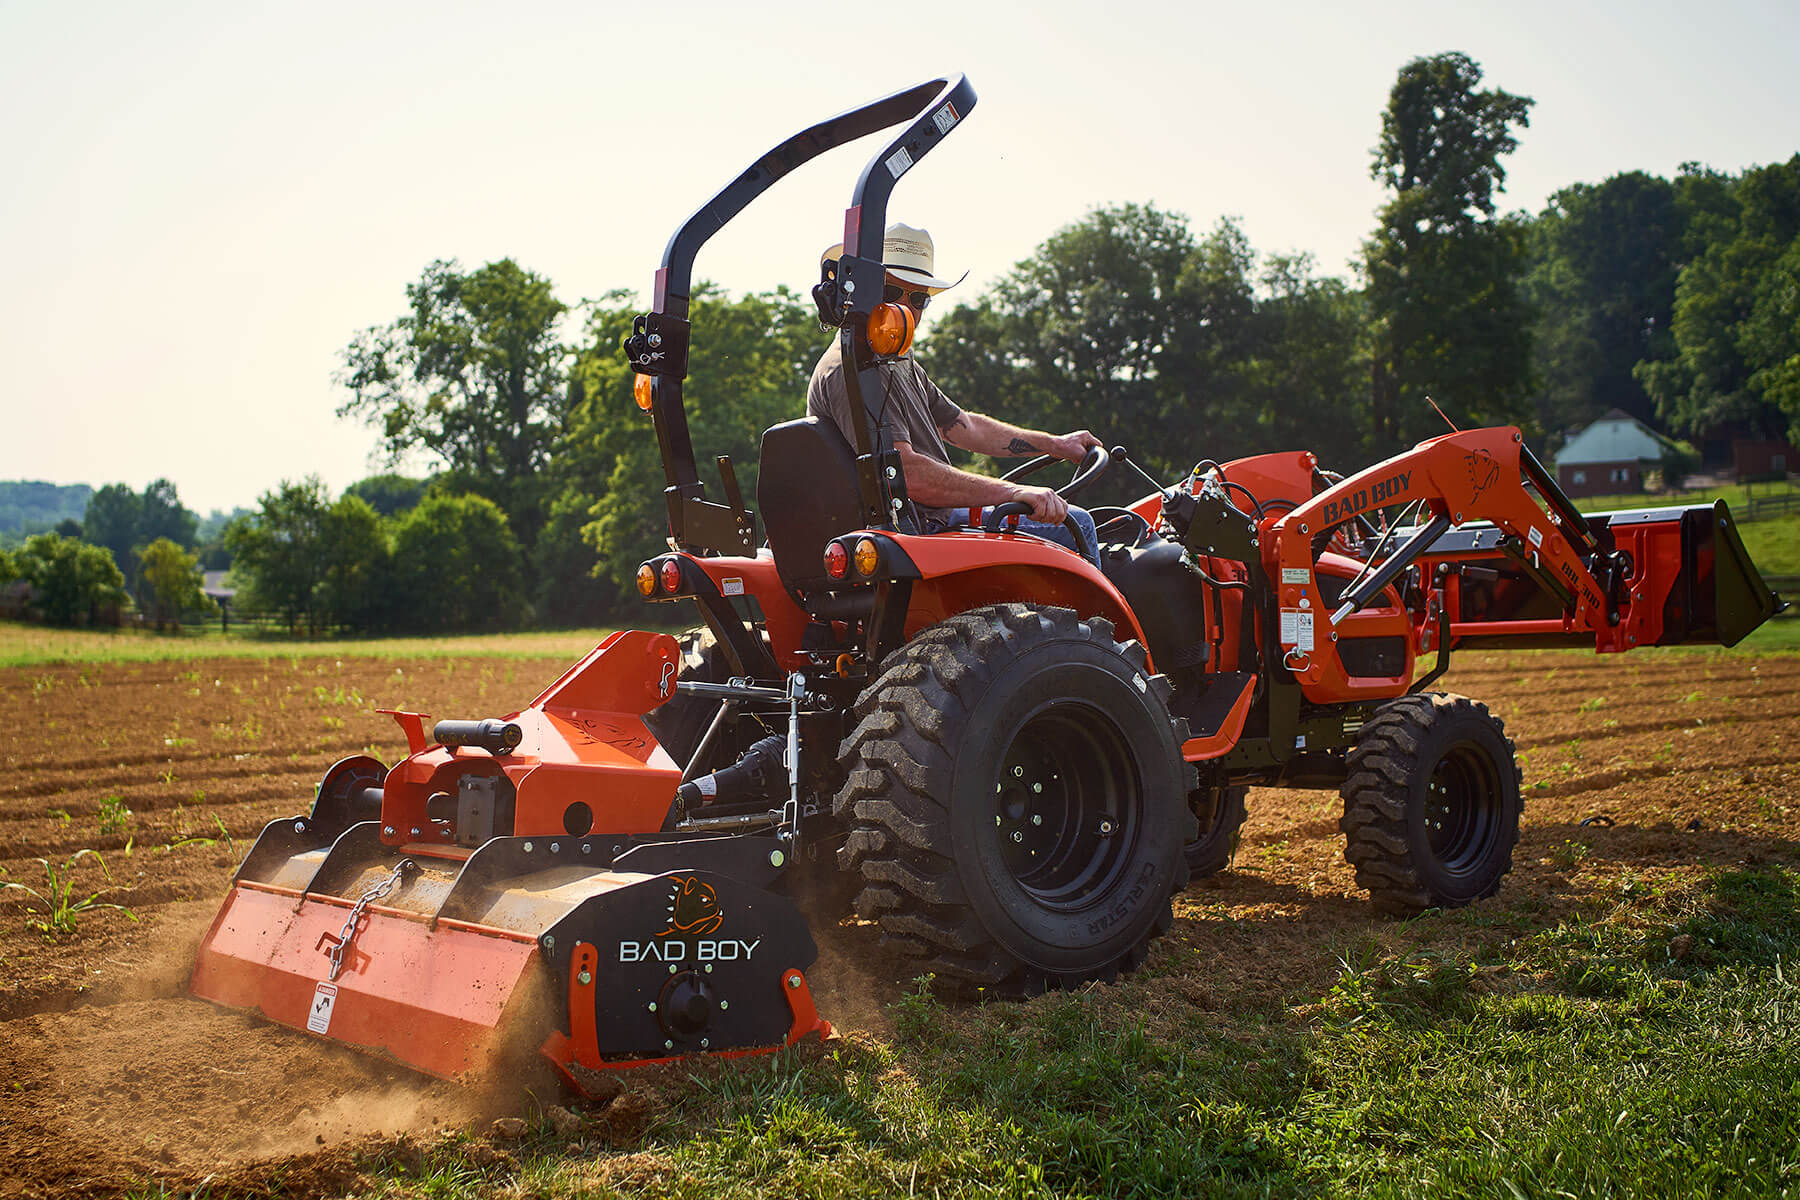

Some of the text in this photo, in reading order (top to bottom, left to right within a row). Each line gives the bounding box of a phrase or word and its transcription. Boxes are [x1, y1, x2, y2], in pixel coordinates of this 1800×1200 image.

[1323, 470, 1412, 525] BAD BOY
[619, 939, 761, 962] BAD BOY
